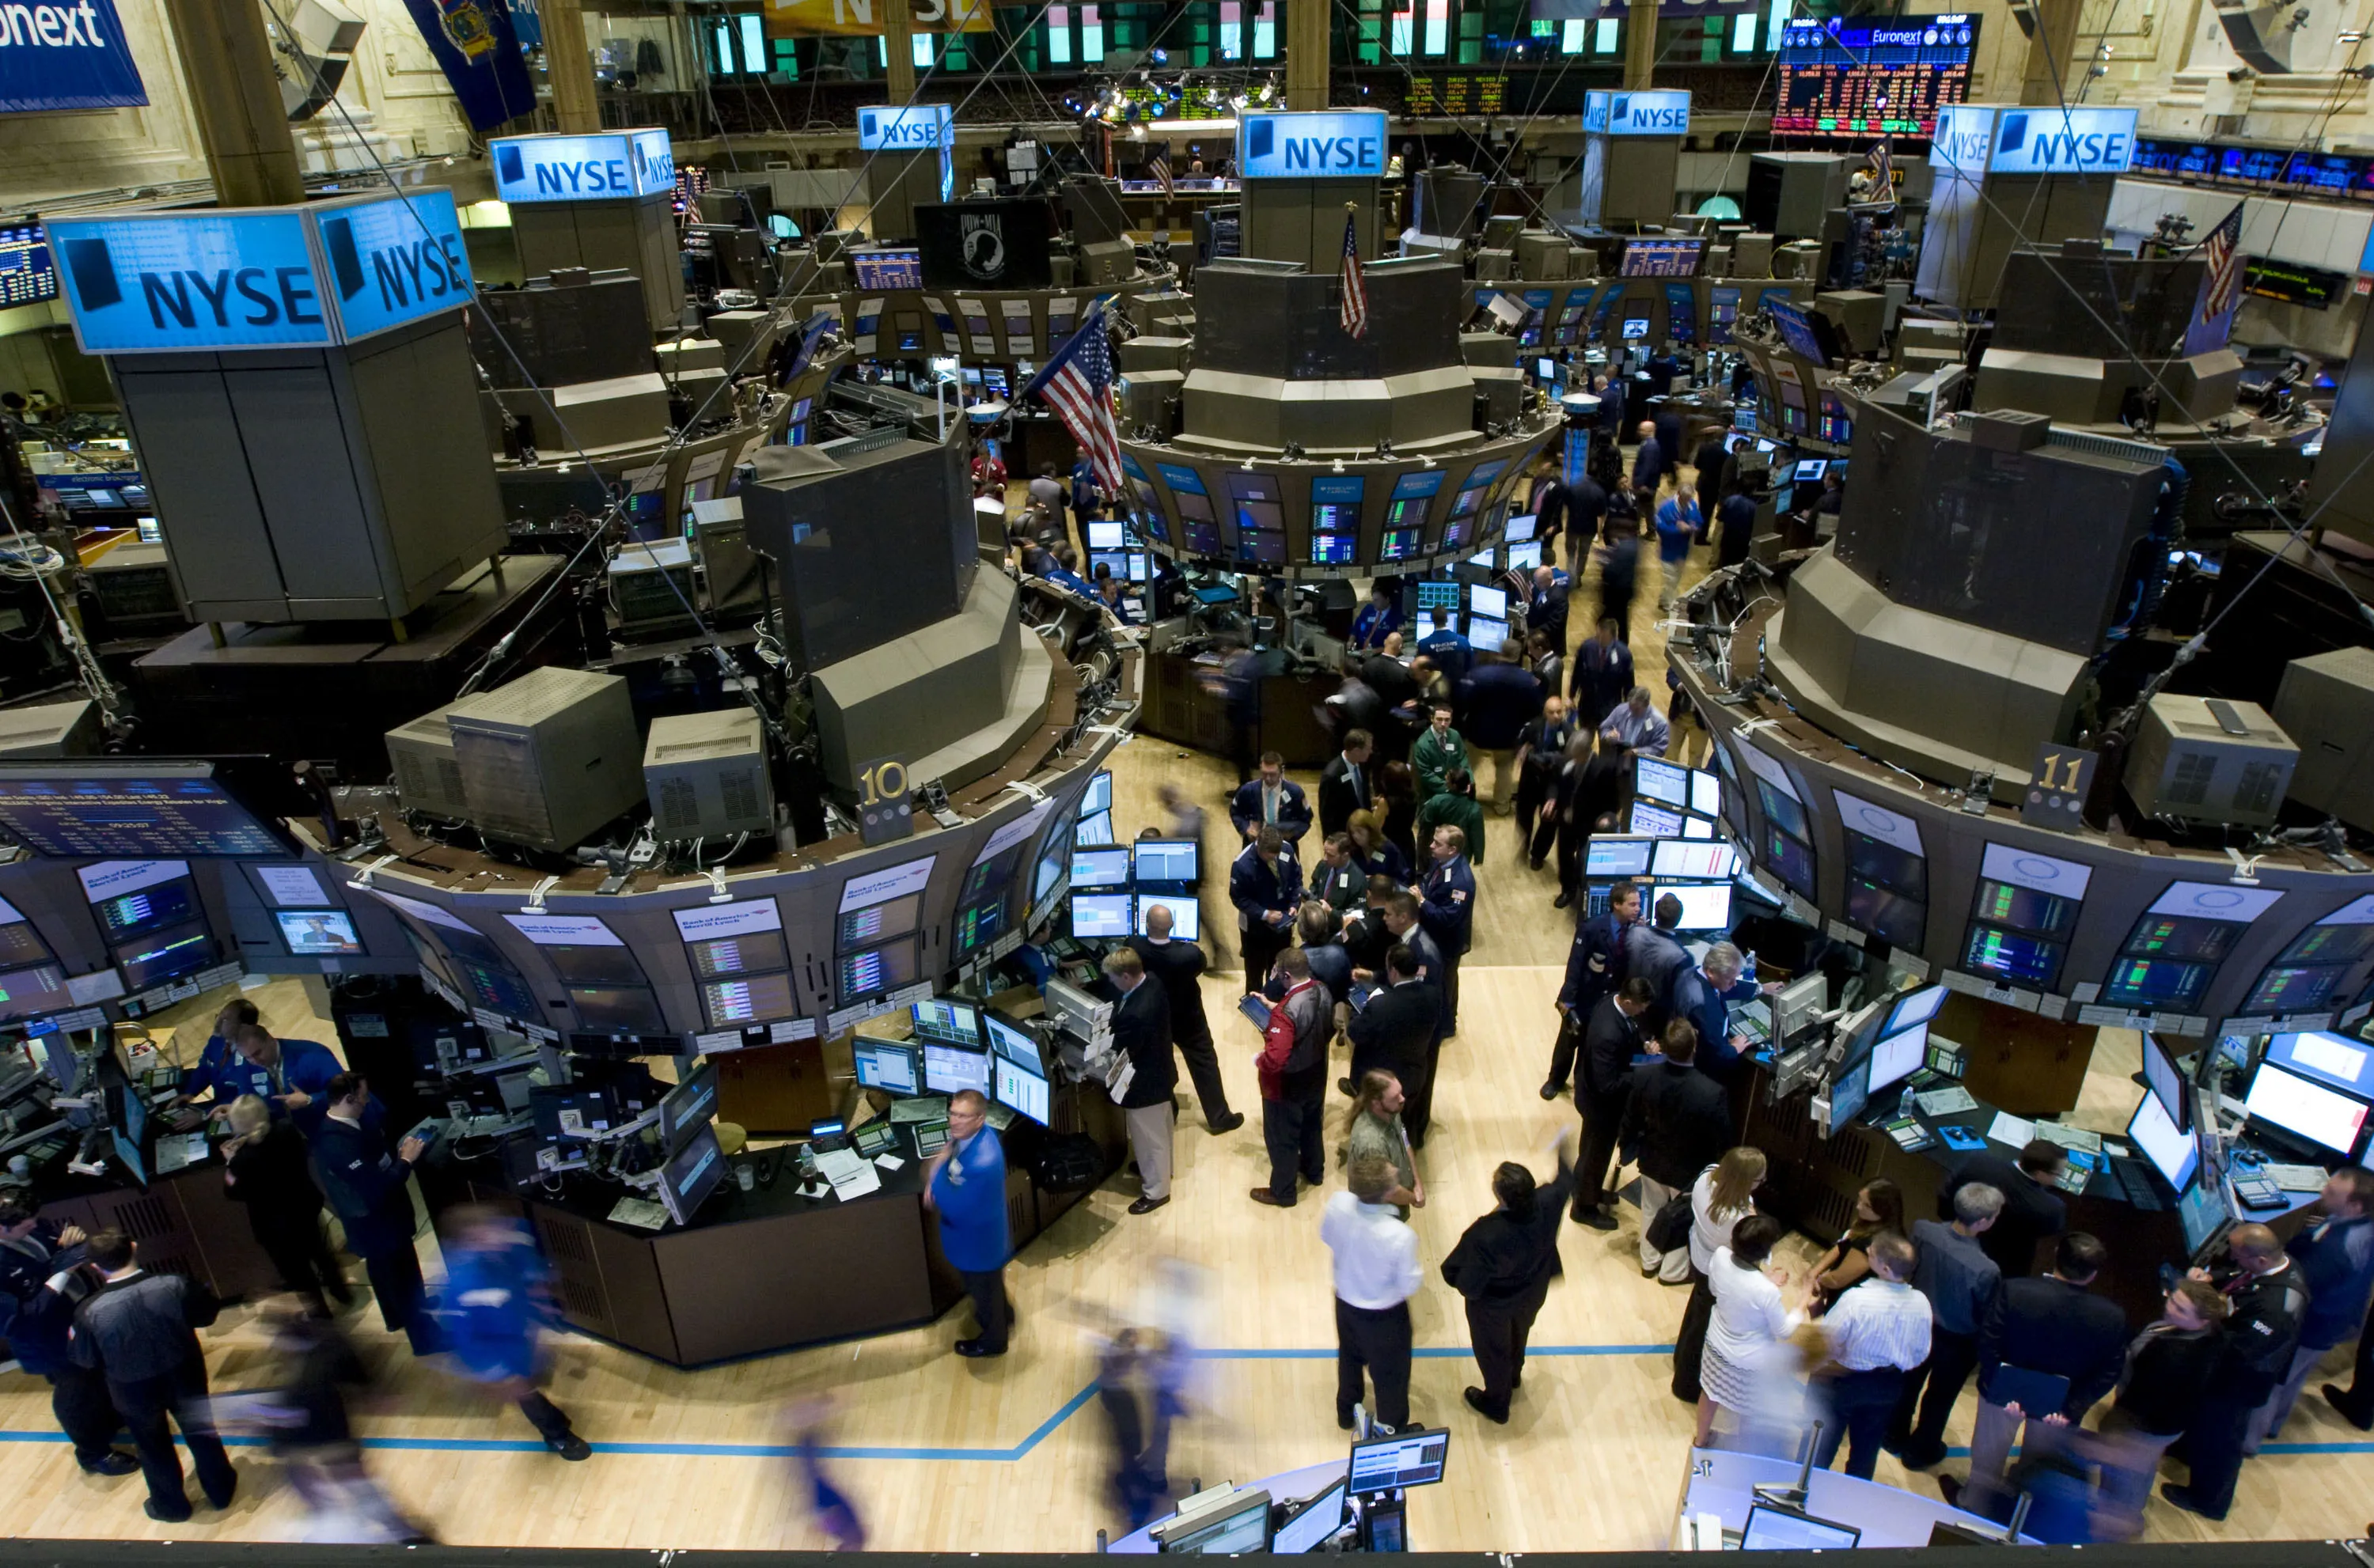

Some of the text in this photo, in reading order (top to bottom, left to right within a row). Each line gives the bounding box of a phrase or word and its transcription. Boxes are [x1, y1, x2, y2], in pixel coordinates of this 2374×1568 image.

[1873, 29, 1921, 44] Euronext
[883, 123, 936, 142] NYSE
[1633, 108, 1687, 127] NYSE
[1285, 137, 1377, 169] NYSE
[1947, 131, 1989, 160] NYSE
[2031, 133, 2126, 165] NYSE
[535, 160, 628, 194] NYSE
[648, 153, 675, 184] NYSE
[372, 233, 468, 312] NYSE
[139, 266, 324, 330] NYSE
[860, 762, 908, 805] 10
[2038, 753, 2083, 793] 11
[88, 873, 108, 884] Bank
[121, 862, 157, 876] America
[89, 869, 147, 888] Merrill Lynch
[715, 912, 750, 922] America
